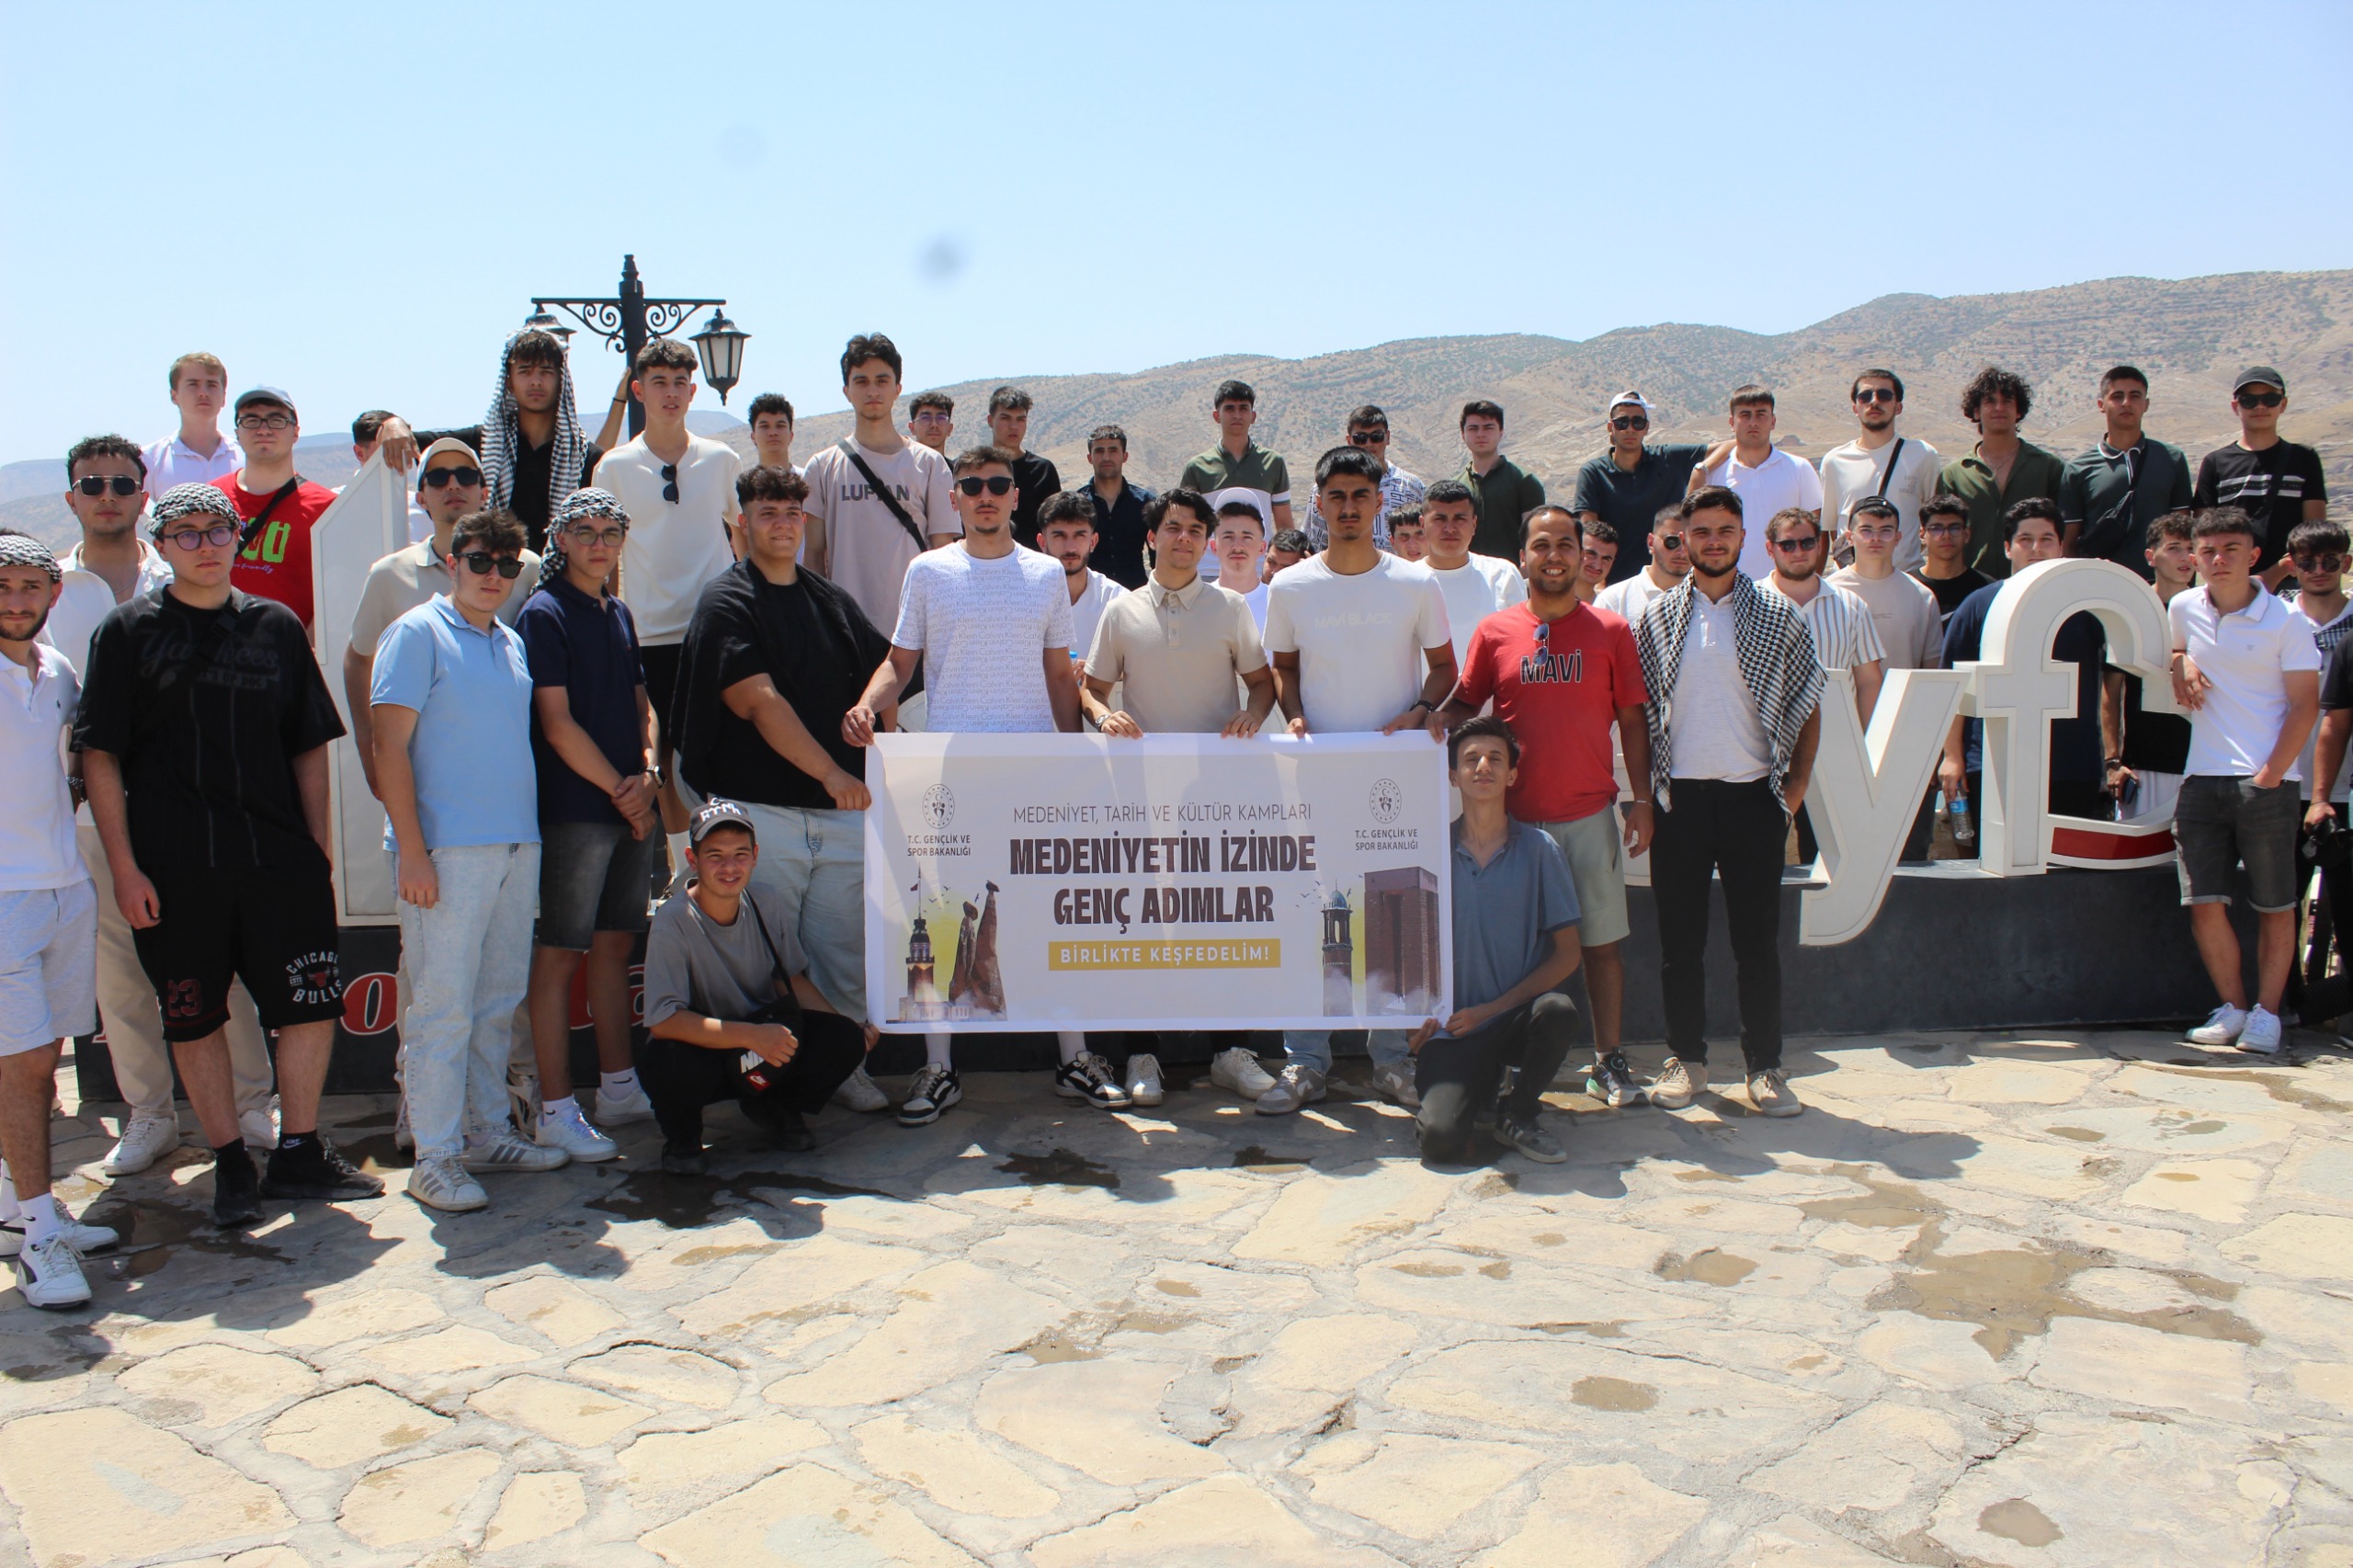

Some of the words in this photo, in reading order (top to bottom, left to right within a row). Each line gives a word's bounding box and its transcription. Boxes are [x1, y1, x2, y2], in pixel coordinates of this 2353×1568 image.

[1347, 612, 1392, 626] BLACK
[139, 628, 279, 677] Yakees
[1014, 802, 1098, 824] MEDENİYET,
[1104, 802, 1146, 822] TARİH
[1153, 805, 1170, 822] VE
[1177, 801, 1232, 822] KÜLTÜR
[1238, 803, 1311, 821] KAMPLARI
[907, 835, 922, 844] T.C.
[924, 833, 958, 846] GENÇLİK
[960, 835, 971, 844] VE
[1355, 830, 1369, 838] T.C.
[1371, 827, 1405, 840] GENÇLİK
[1407, 828, 1418, 837] VE
[1356, 842, 1376, 851] SPOR
[1377, 839, 1418, 850] BAKANLIĞI
[907, 847, 928, 857] SPOR
[929, 846, 971, 857] BAKANLIĞI
[1009, 830, 1211, 875] MEDENİYETİN
[1221, 829, 1316, 872] İZİNDE
[1053, 887, 1131, 935] GENÇ
[1141, 886, 1274, 924] ADIMLAR
[1061, 944, 1142, 963] BİRLİKTE
[1150, 942, 1269, 965] KEŞFEDELİM!
[166, 979, 204, 1017] 23
[740, 1050, 765, 1074] NI
